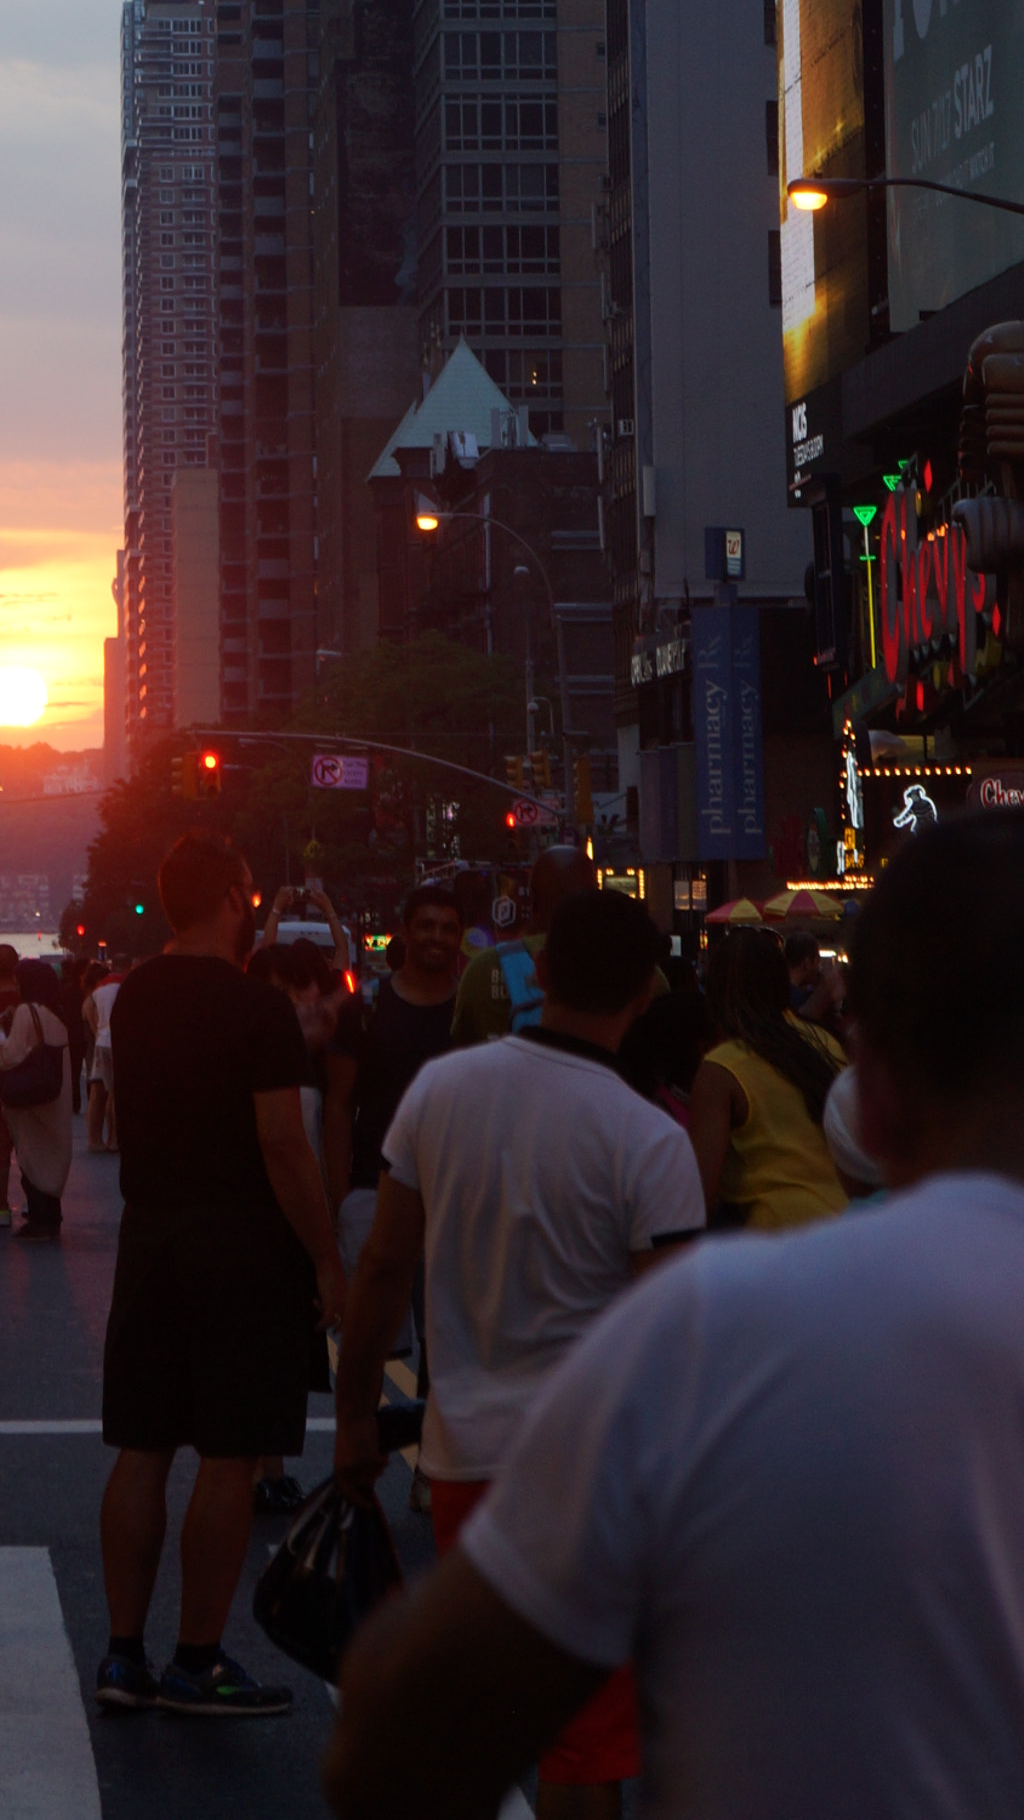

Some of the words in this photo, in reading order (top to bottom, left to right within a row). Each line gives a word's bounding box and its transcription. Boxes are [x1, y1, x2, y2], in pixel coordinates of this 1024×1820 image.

[954, 44, 995, 140] STARZ
[701, 679, 732, 835] pharmacy
[737, 679, 763, 835] pharmacy
